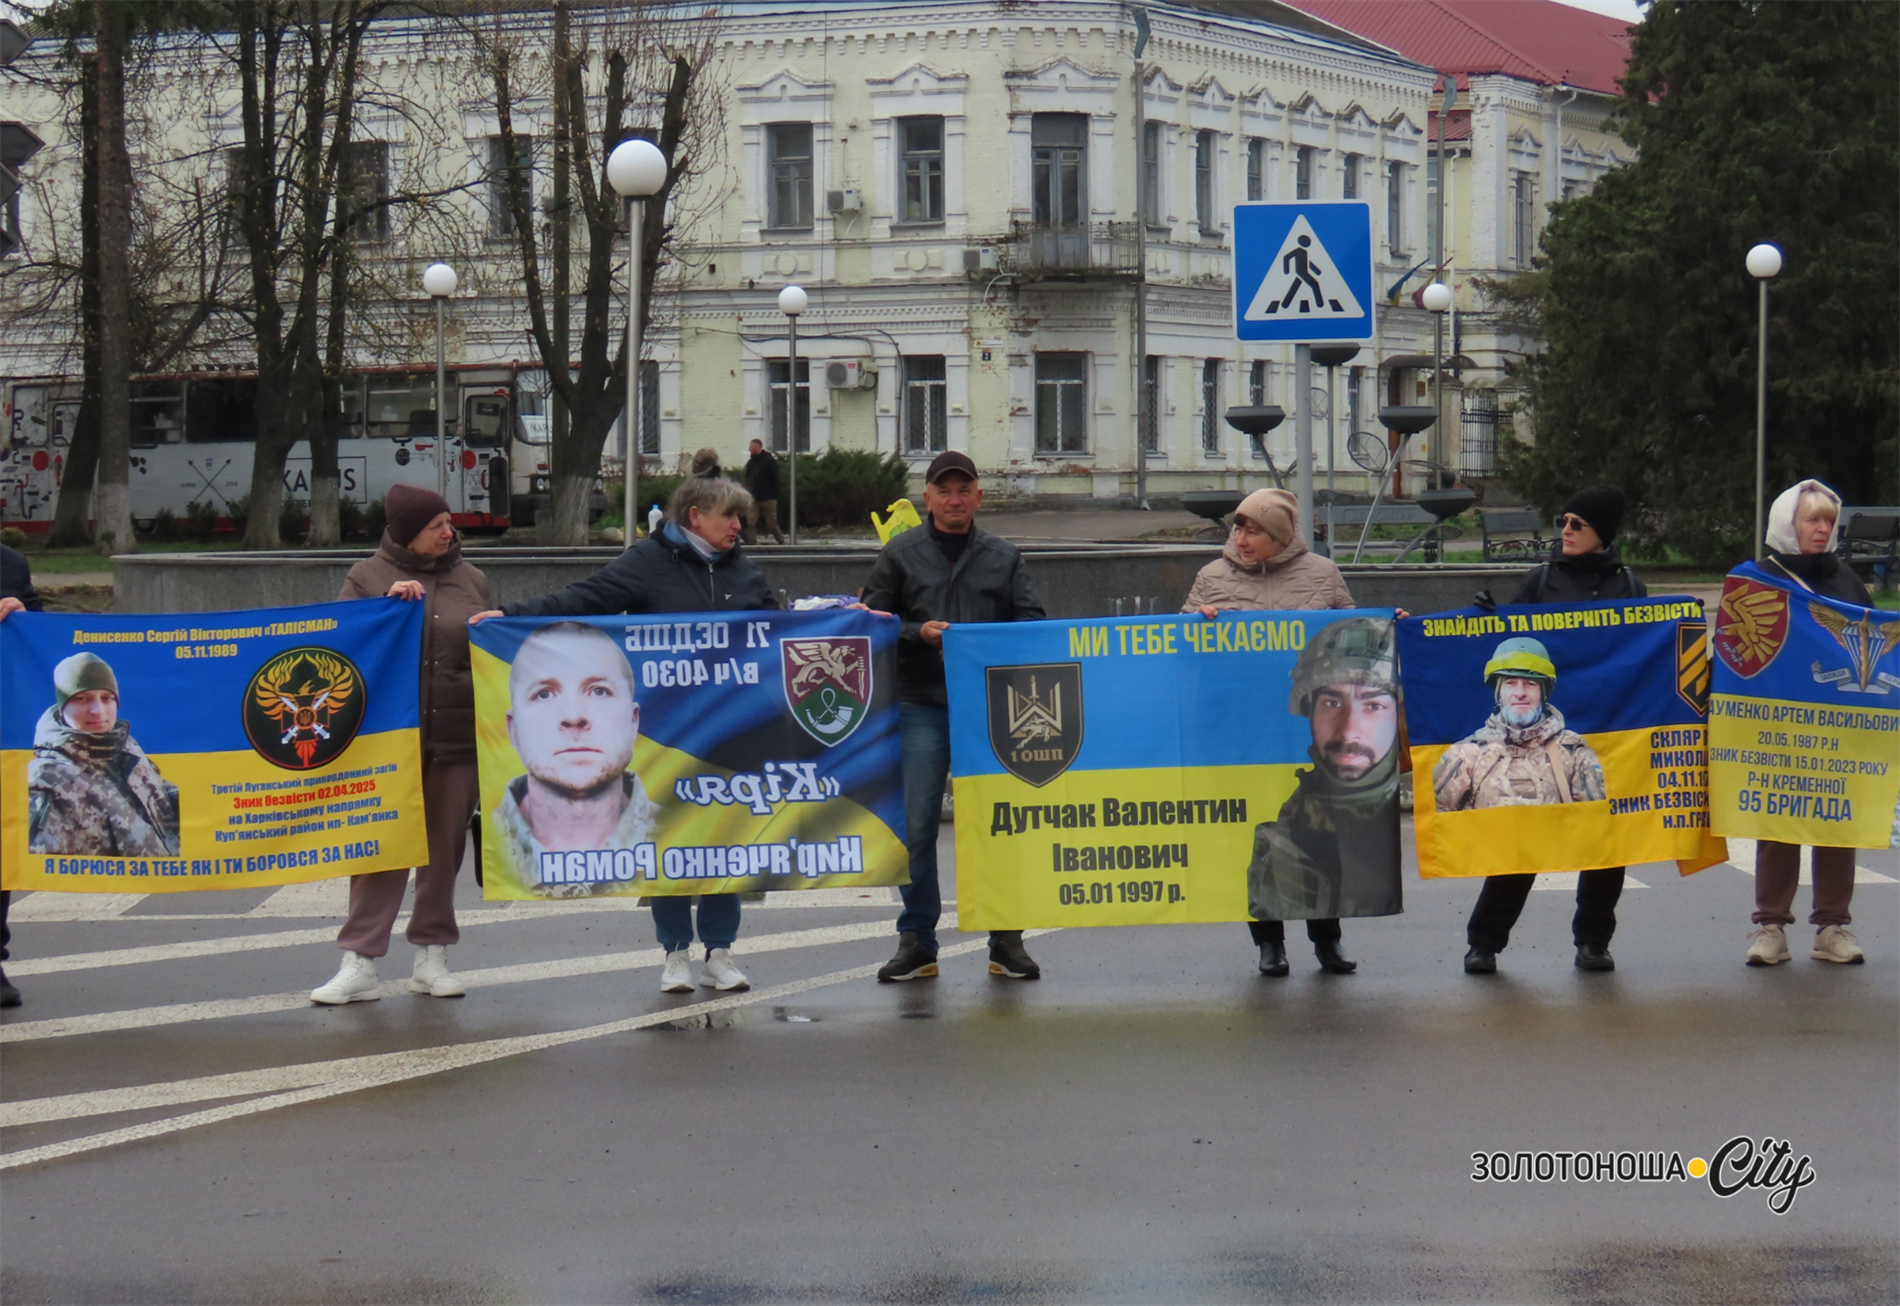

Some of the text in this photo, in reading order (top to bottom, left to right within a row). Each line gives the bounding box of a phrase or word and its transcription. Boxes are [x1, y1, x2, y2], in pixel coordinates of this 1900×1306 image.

[73, 618, 337, 644] Денисенко Сергій Вікторович «ТАЛІСМАН»
[1422, 602, 1701, 638] ЗНАЙДІТЬ ТА ПОВЕРНІТЬ БЕЗВІСТИ
[175, 643, 238, 659] 05.11.1989
[1068, 620, 1306, 657] МИ ТЕБЕ ЧЕКАЄМО
[1772, 706, 1814, 725] АРТЕМ
[1818, 710, 1900, 732] ВАСИЛЬОВИ
[1650, 729, 1701, 748] СКЛЯР
[1821, 737, 1839, 751] Р.Н
[1011, 749, 1064, 762] 1 ОШП
[1709, 748, 1888, 776] ЗНИК БЕЗВІСТИ 15.01.2023 РОКУ
[211, 763, 397, 795] Третій Луганський прикордонний загін
[1748, 772, 1847, 795] Р-Н КРЕМЕННОЇ
[233, 780, 376, 809] Зник безвісти 02.04.2025
[1609, 795, 1651, 815] ЗНИК
[1738, 790, 1852, 822] 95 БРИГАДА
[229, 796, 381, 825] на Харківському напрямку
[991, 798, 1247, 836] Дутчак Валентин
[215, 825, 287, 842] Куп'янський
[290, 820, 324, 836] район
[44, 859, 54, 874] Я
[58, 859, 125, 876] БОРЮСЯ
[129, 860, 148, 876] ЗА
[151, 860, 187, 876] ТЕБЕ
[191, 859, 212, 875] ЯК
[224, 858, 242, 874] ТИ
[246, 853, 317, 872] БОРОВСЯ
[321, 848, 341, 864] ЗА
[344, 840, 380, 860] НАС!
[1052, 843, 1188, 872] Іванович
[1059, 881, 1185, 905] 05.01 1997 р.
